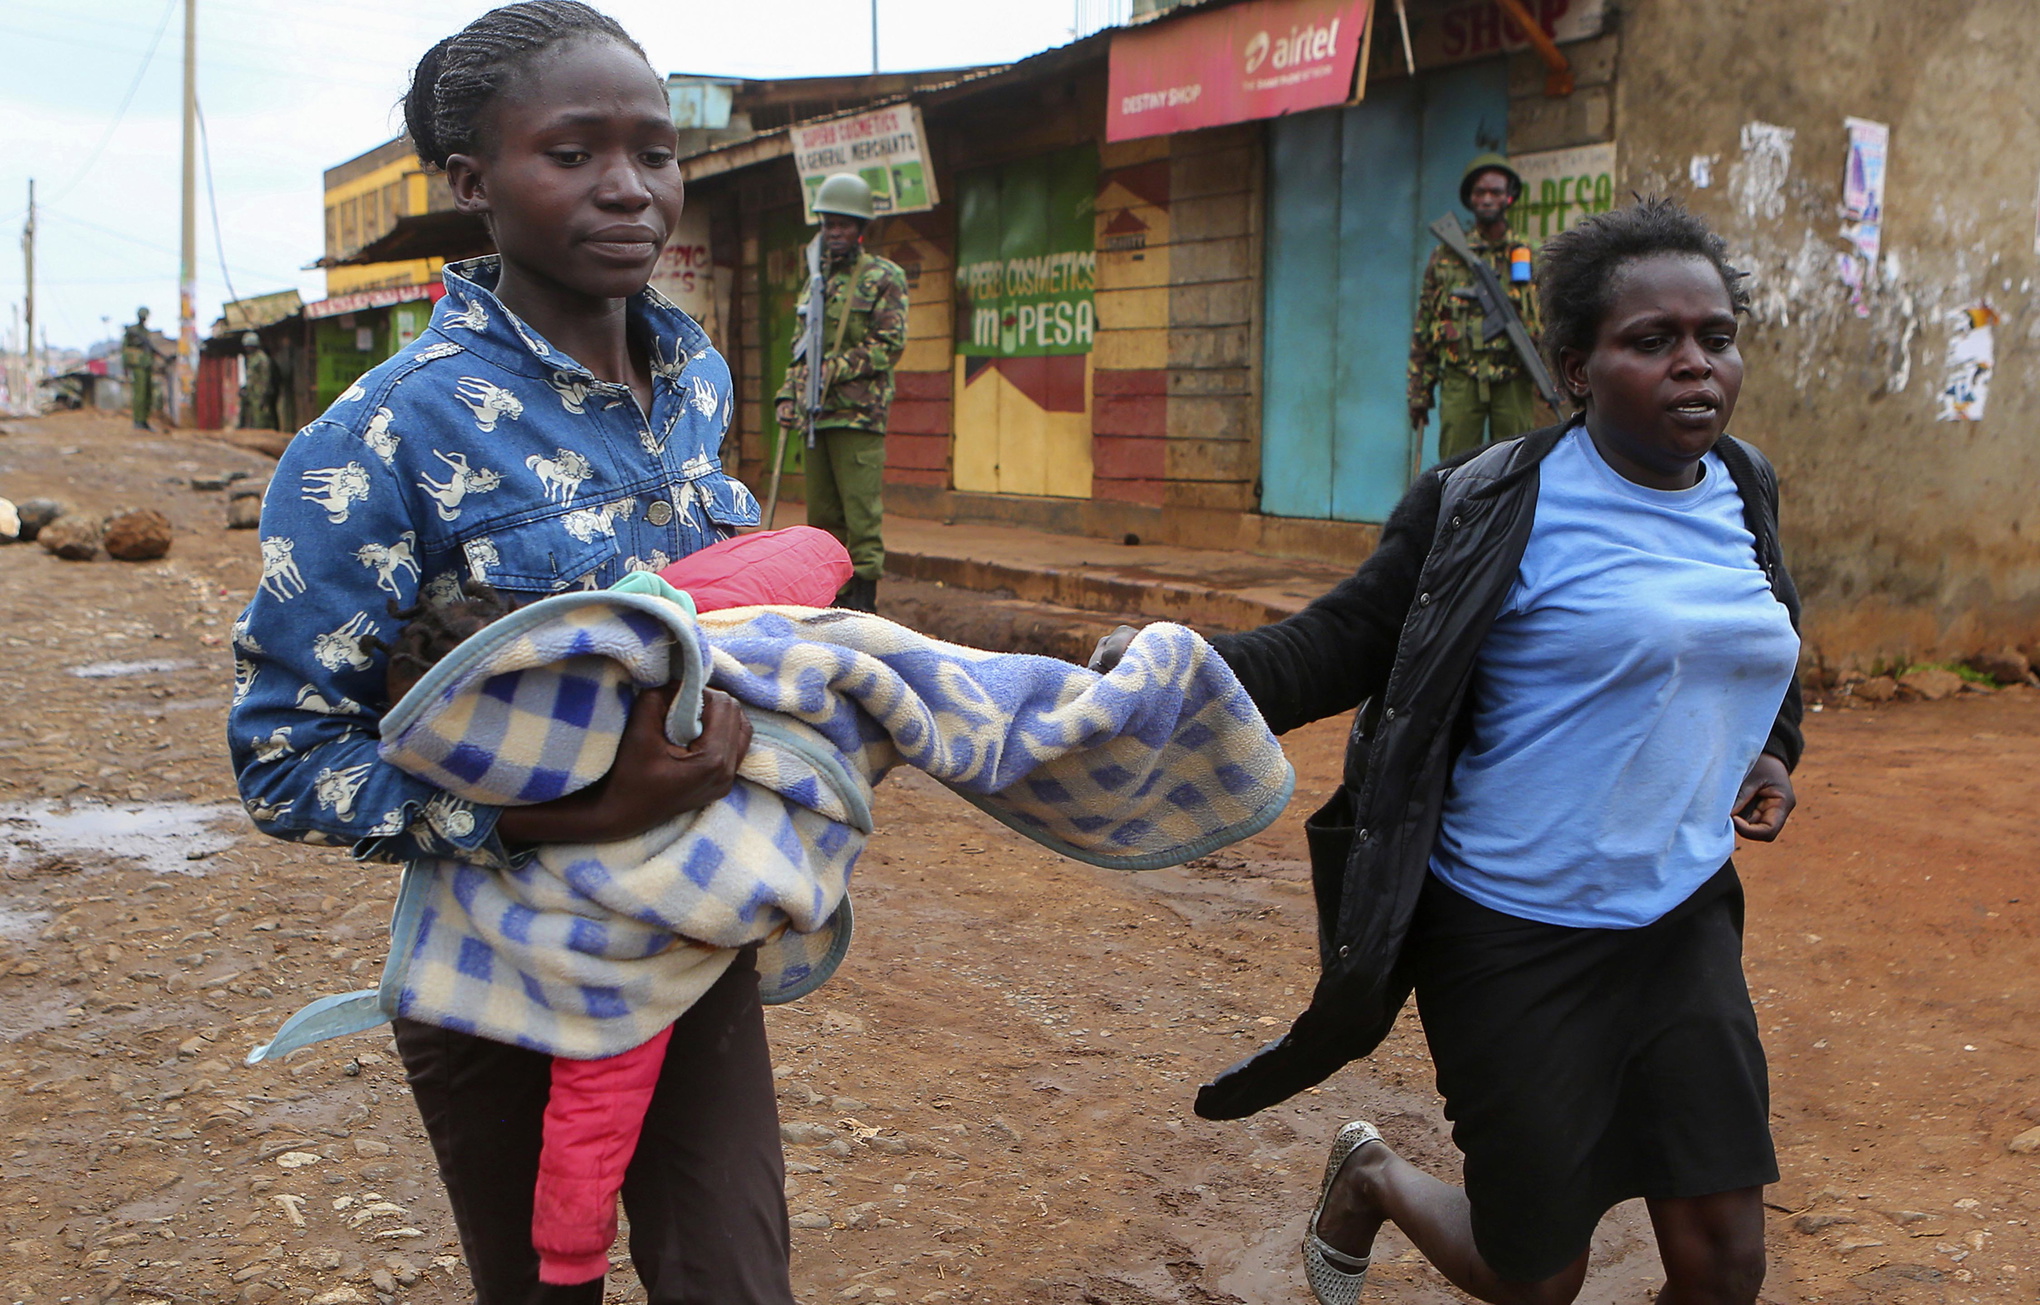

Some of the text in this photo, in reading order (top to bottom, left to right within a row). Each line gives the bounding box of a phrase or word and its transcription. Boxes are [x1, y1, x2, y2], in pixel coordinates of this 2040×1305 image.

[1272, 17, 1341, 69] airtel
[1122, 83, 1202, 115] DESTINY SHOP
[839, 113, 900, 140] COSMETICS
[807, 147, 846, 170] GENERAL
[852, 132, 915, 161] MERCHANTS
[1007, 250, 1097, 297] COSMETICS
